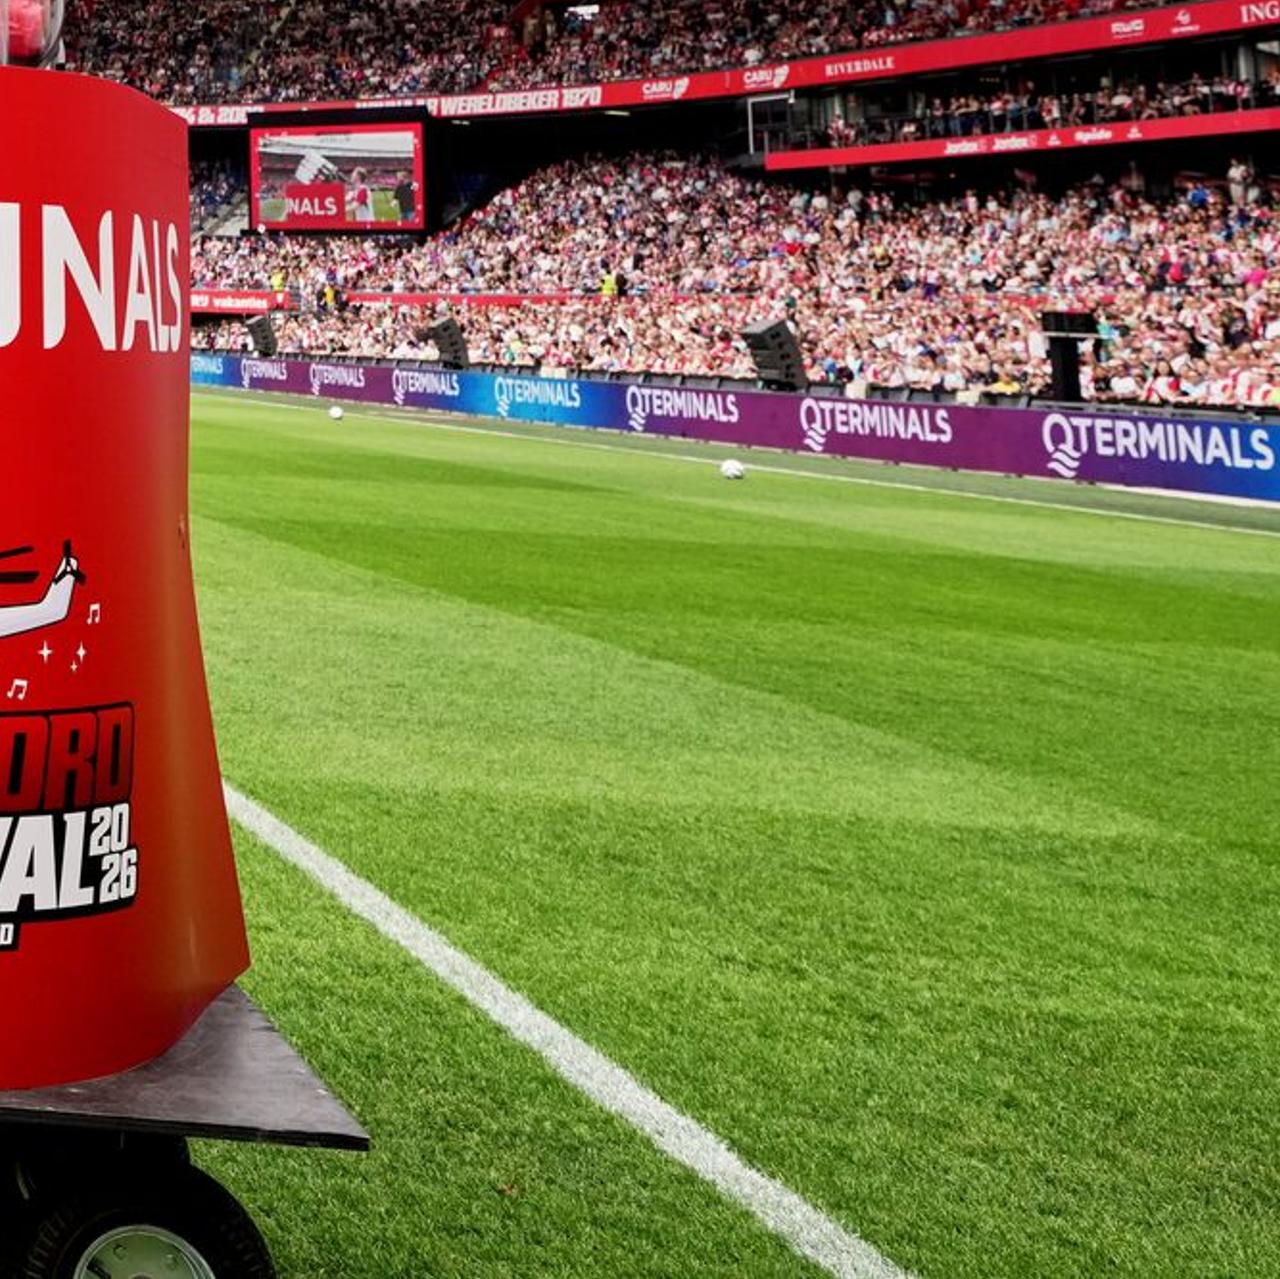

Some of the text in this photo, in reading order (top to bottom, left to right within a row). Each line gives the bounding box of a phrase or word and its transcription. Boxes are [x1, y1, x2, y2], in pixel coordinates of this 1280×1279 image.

[1241, 0, 1280, 23] ING
[825, 57, 895, 76] RIVERDALE
[441, 91, 559, 115] WERELDBEKER
[561, 86, 602, 108] 1970
[392, 368, 459, 405] QTERMINALS
[495, 376, 581, 417] QTERMINALS
[626, 385, 739, 432] QTERMINALS
[800, 397, 953, 452] QTERMINALS
[1042, 413, 1276, 478] QTERMINALS
